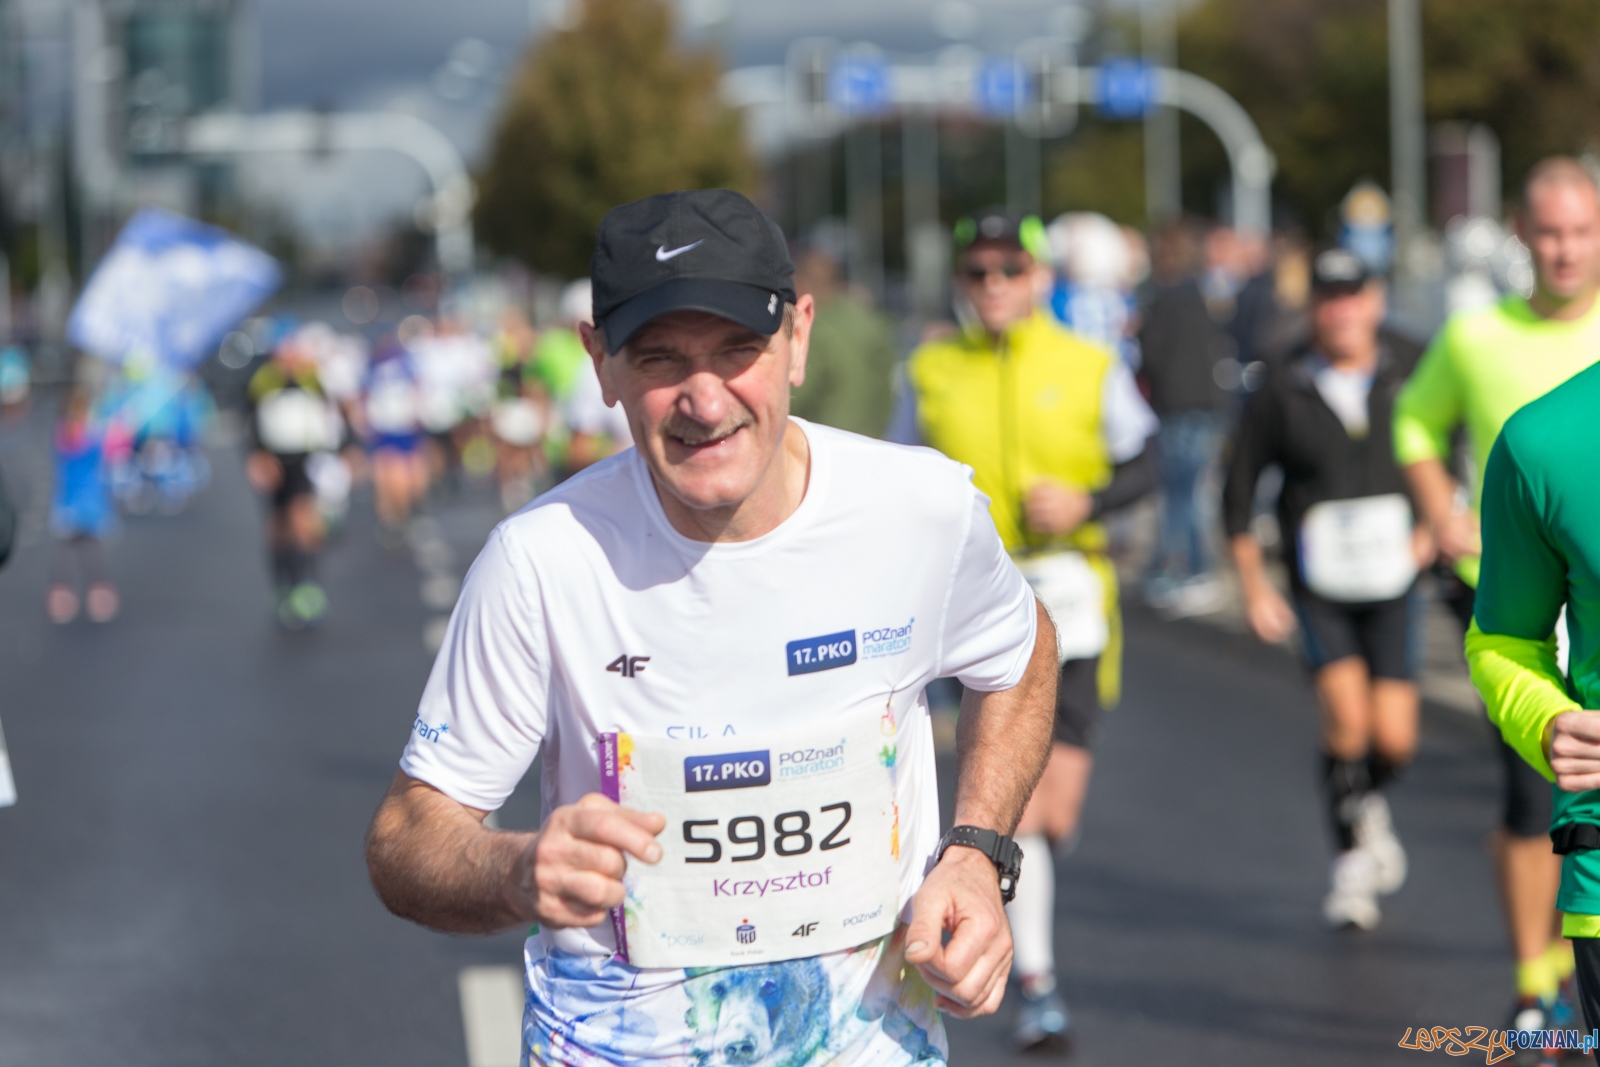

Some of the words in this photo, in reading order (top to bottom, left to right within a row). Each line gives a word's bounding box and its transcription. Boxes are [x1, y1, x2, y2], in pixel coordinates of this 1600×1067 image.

[863, 635, 911, 655] maraton
[606, 654, 650, 677] 4F
[780, 756, 845, 777] maraton
[683, 801, 852, 863] 5982
[713, 866, 832, 898] Krzysztof
[792, 921, 820, 937] 4F
